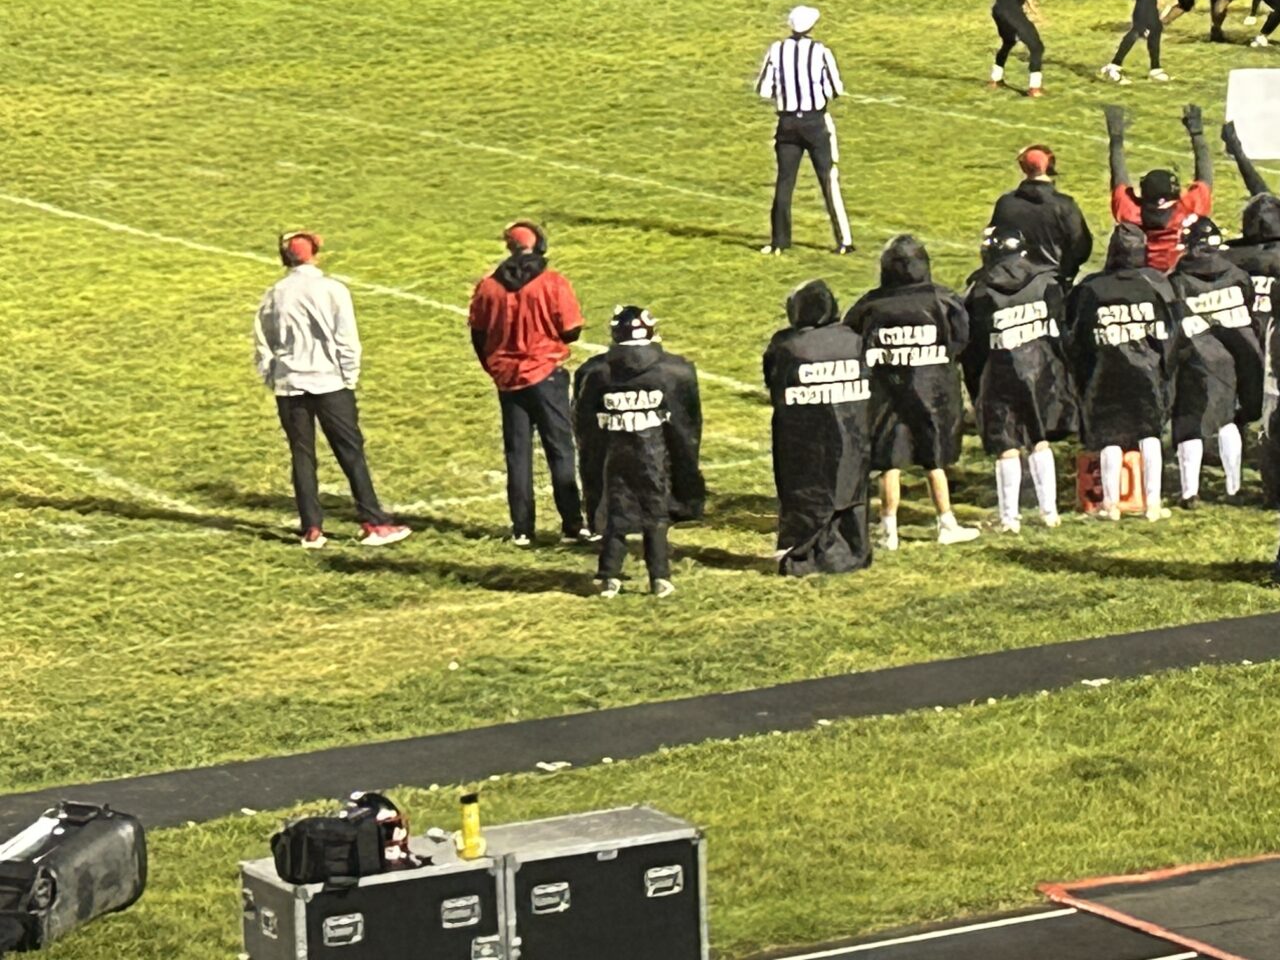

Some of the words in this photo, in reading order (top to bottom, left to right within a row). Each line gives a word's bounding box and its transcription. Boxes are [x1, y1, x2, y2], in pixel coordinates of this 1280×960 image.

[878, 324, 938, 346] COZAD
[798, 359, 860, 384] COZAD
[603, 390, 663, 411] COZAD
[784, 379, 872, 406] FOOTBALL
